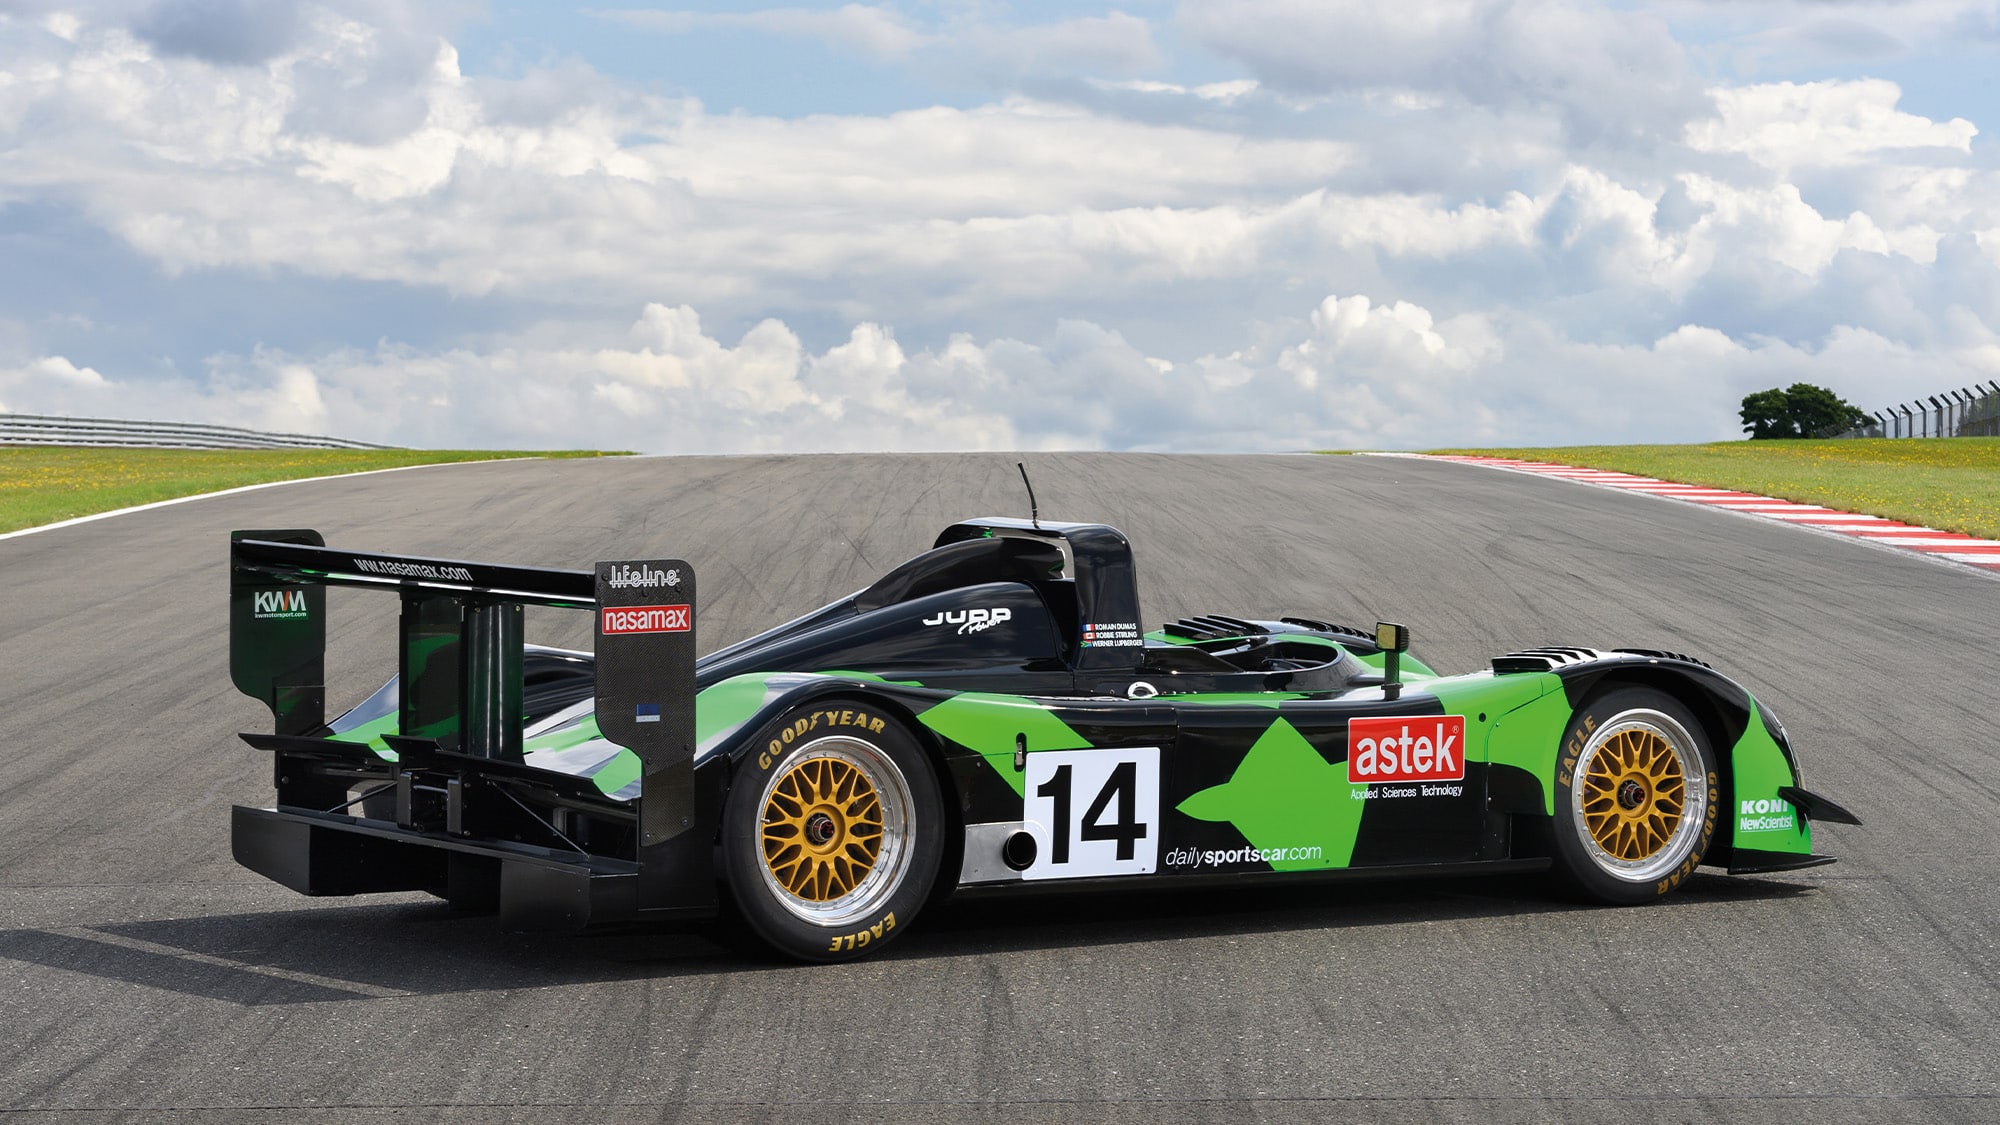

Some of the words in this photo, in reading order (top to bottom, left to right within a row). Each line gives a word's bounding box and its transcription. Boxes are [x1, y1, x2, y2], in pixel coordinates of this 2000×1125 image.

[254, 590, 307, 613] KWM
[605, 609, 688, 631] nasamax
[922, 608, 1011, 626] JUDD
[1094, 623, 1116, 631] ROMAIN
[1117, 622, 1137, 630] DUMAS
[1092, 640, 1114, 648] WERNER
[1558, 714, 1597, 788] EAGLE
[1350, 787, 1379, 800] Applied
[1382, 785, 1417, 799] Sciences
[1420, 783, 1463, 797] Technology
[1037, 761, 1147, 864] 14
[1740, 799, 1788, 815] KONI
[1165, 846, 1321, 869] dailysportscar.com
[828, 911, 897, 952] EAGLE
